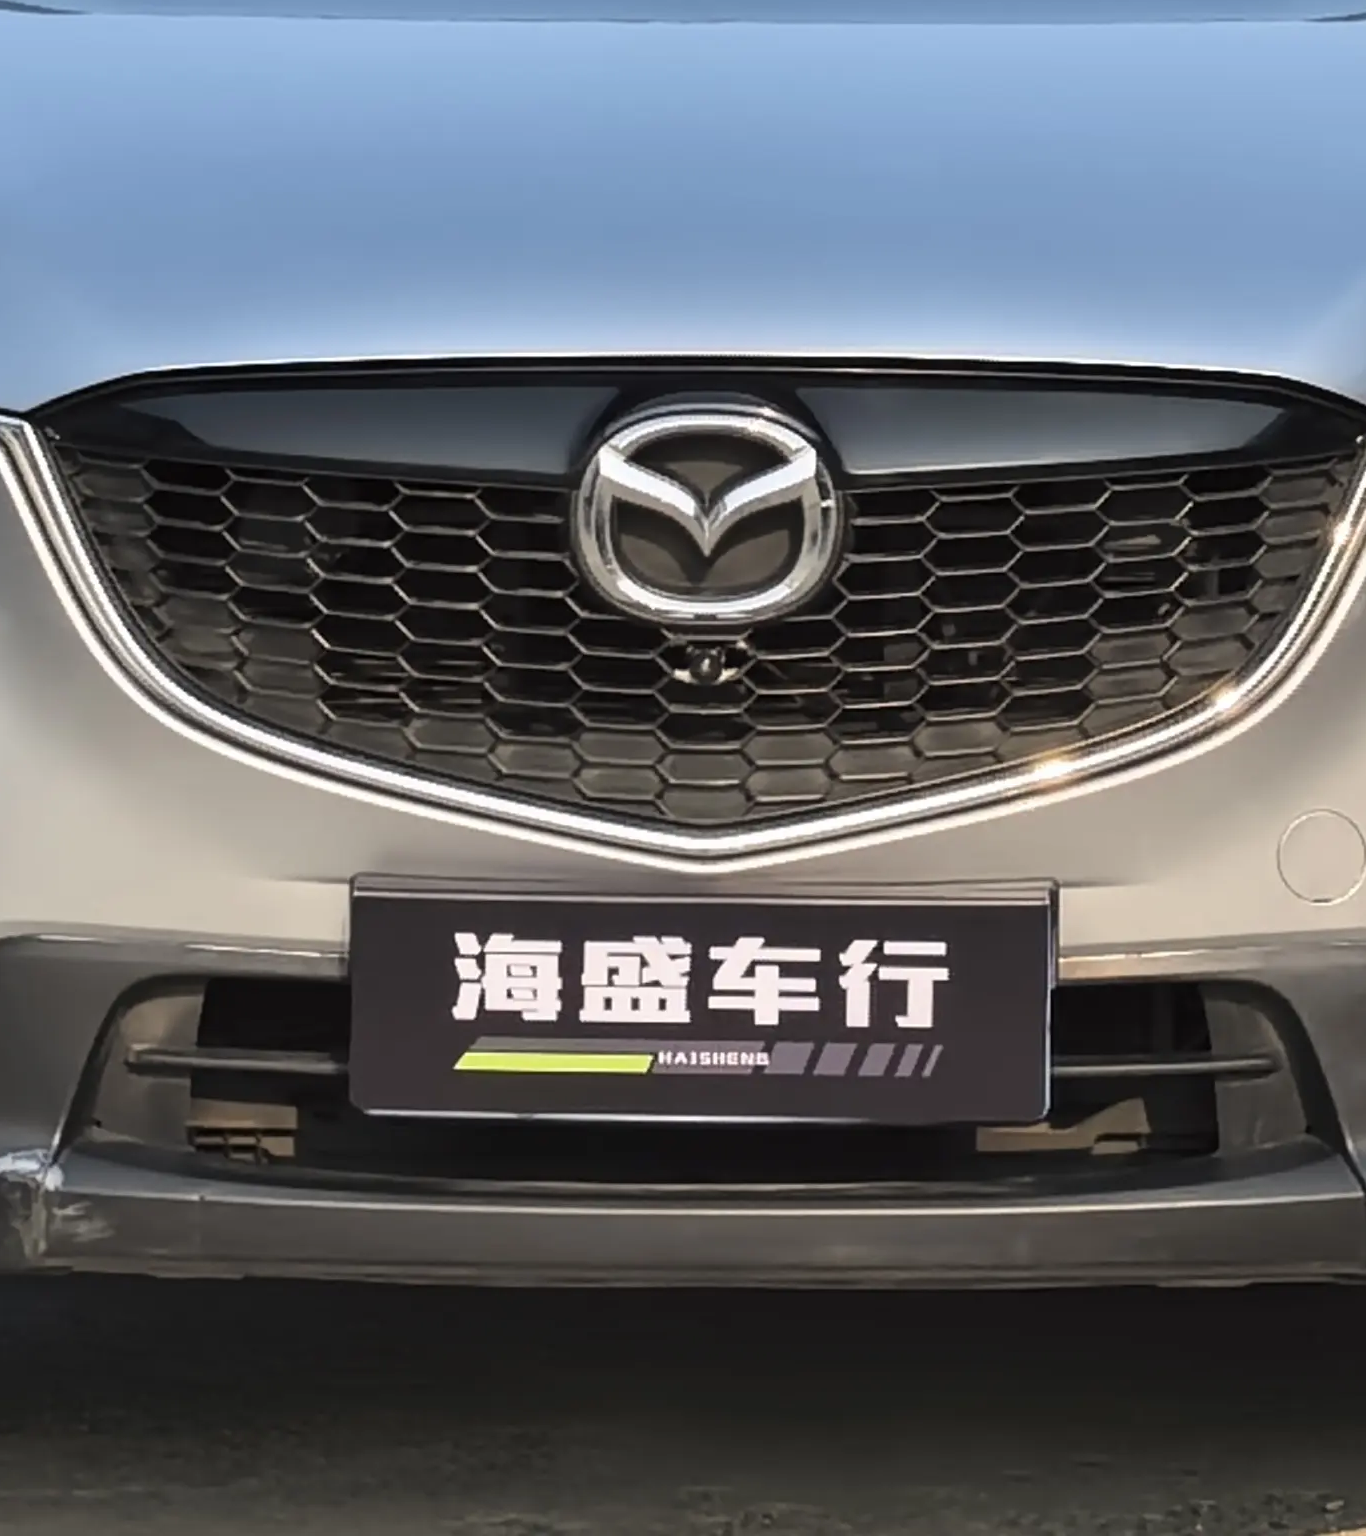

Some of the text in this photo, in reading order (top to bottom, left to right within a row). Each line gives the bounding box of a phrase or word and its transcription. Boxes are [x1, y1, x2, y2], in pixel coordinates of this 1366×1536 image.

[452, 932, 950, 1029] 海盛车行
[657, 1050, 770, 1066] HAISHENG
